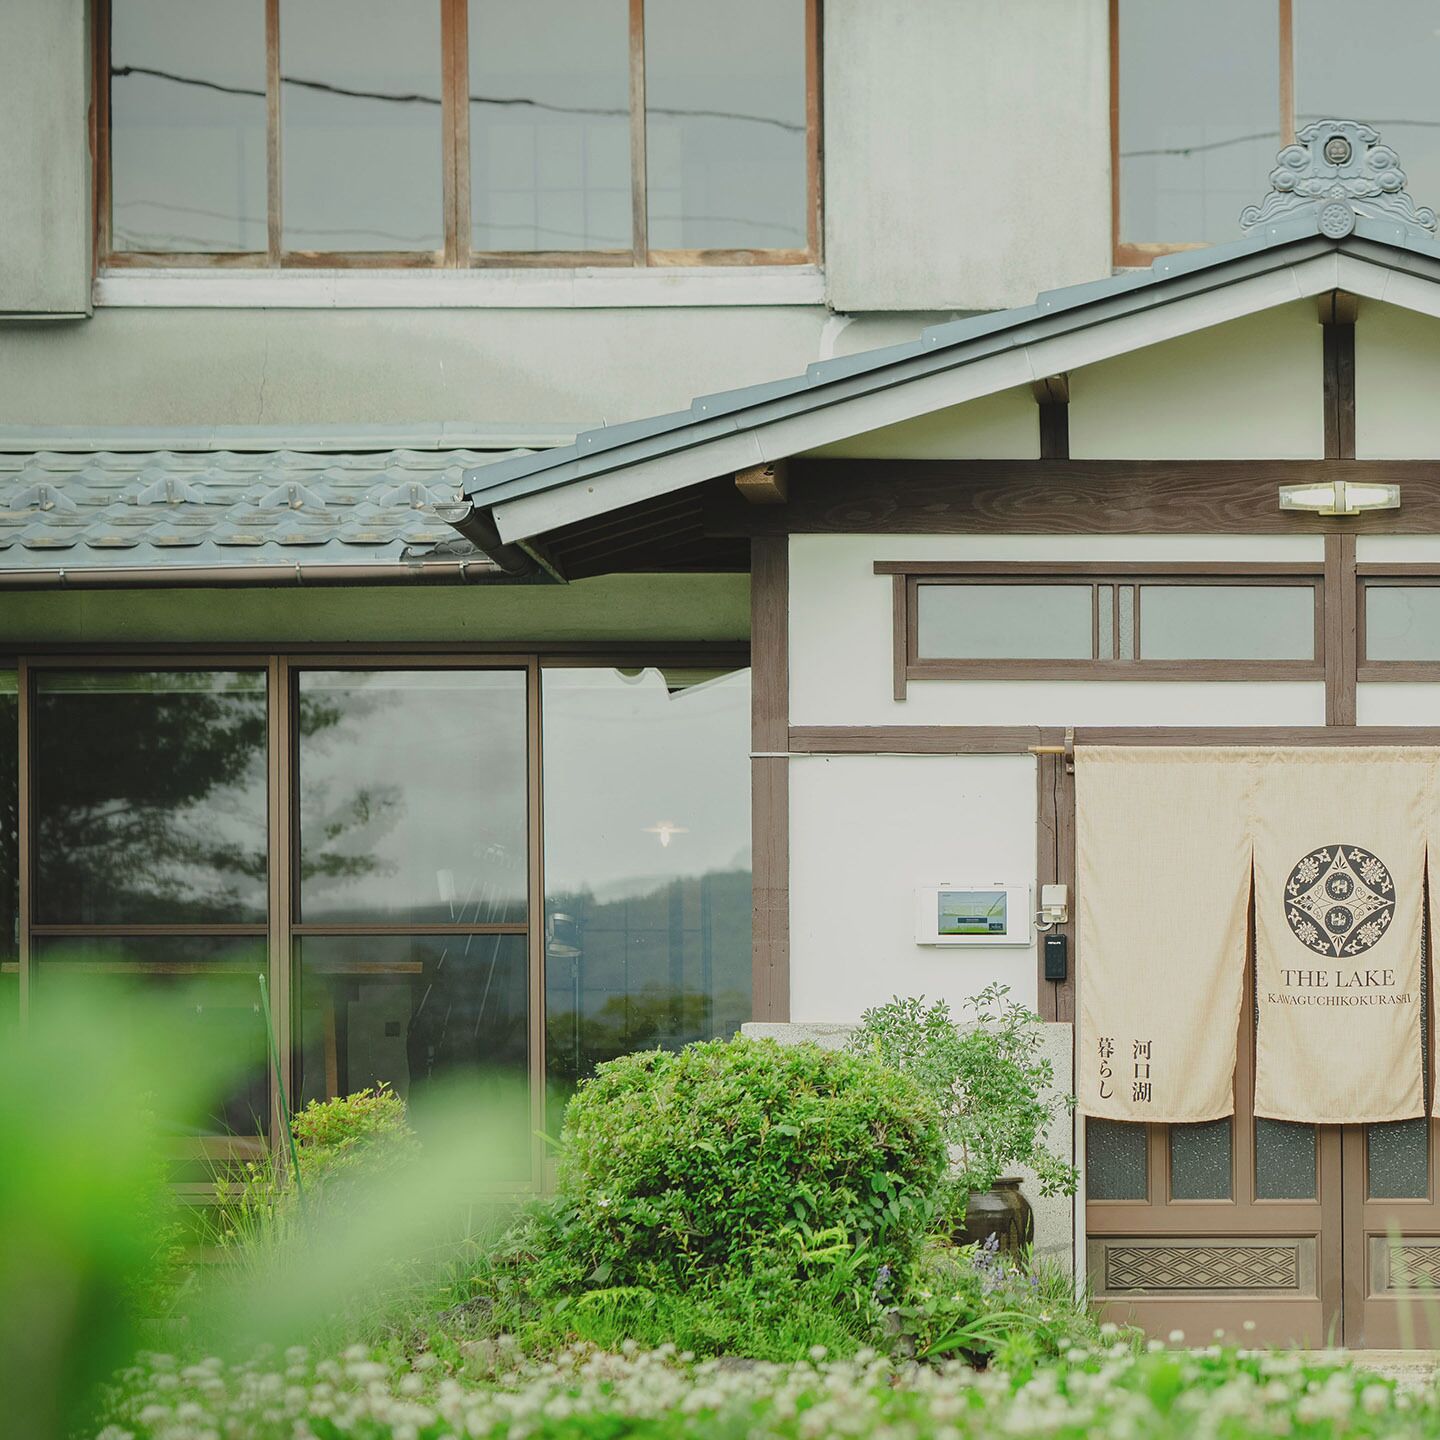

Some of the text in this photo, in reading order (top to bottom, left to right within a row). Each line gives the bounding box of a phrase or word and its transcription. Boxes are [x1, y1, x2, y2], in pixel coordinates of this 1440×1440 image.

[1280, 969, 1396, 988] THE LAKE
[1267, 993, 1411, 1006] KAWAGUCHIKOKURASHI
[1097, 1037, 1114, 1099] 暮らし
[1132, 1039, 1152, 1103] 河口湖
